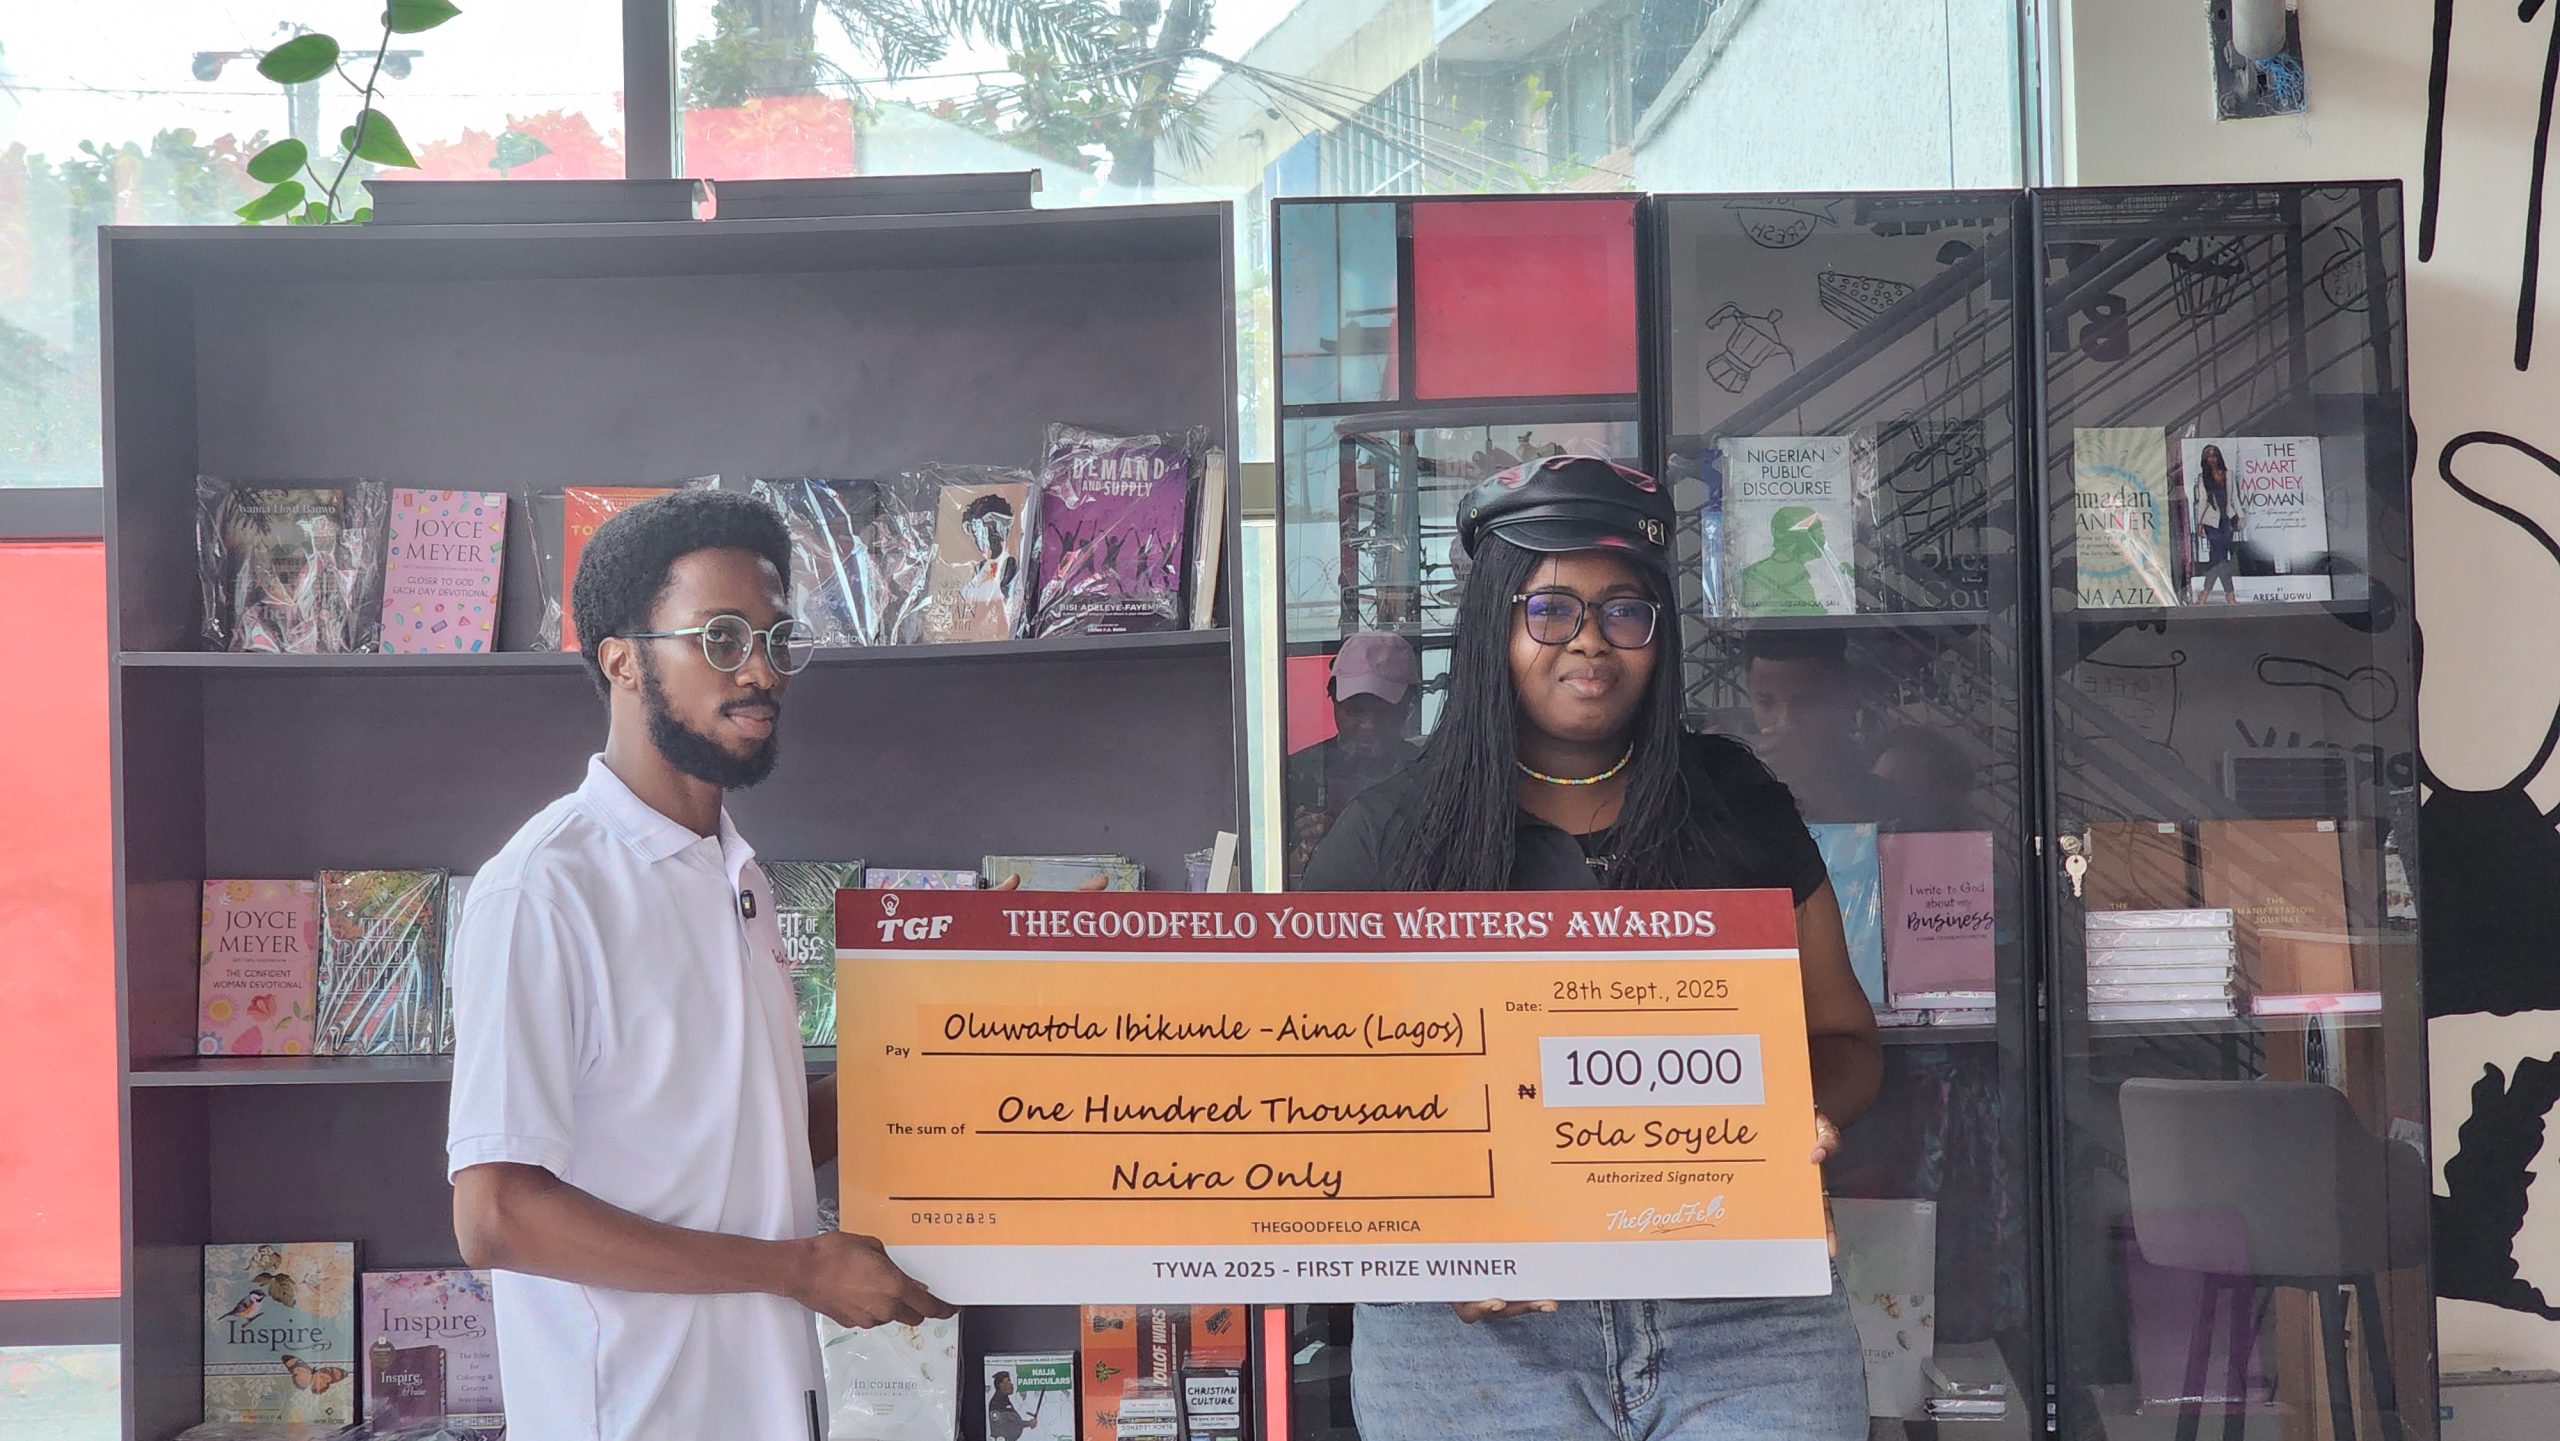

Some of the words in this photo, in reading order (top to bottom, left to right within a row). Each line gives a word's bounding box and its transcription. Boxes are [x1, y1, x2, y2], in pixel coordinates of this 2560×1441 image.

[1747, 449, 1826, 464] NIGERIAN
[2264, 443, 2295, 457] THE
[1073, 456, 1165, 481] DEMAND
[1761, 466, 1813, 480] PUBLIC
[2246, 460, 2297, 474] SMART
[1083, 480, 1101, 491] AND
[1103, 480, 1153, 497] SUPPLY
[1743, 481, 1832, 496] DISCOURSE
[2241, 476, 2303, 490] MONEY
[2239, 492, 2305, 506] WOMAN
[274, 504, 299, 515] Lloyd
[303, 504, 336, 514] Banwo
[2076, 511, 2156, 531] ANNER
[414, 519, 483, 540] JOYCE
[571, 525, 593, 536] TO
[406, 543, 484, 562] MEYER
[407, 576, 438, 585] CLOSER
[442, 577, 453, 586] TO
[455, 578, 474, 587] GOD
[393, 586, 415, 595] EACH
[418, 587, 436, 596] DAY
[438, 588, 490, 597] DEVOTIONAL
[2110, 588, 2155, 605] AZIZ
[2253, 593, 2280, 601] ARESE
[2283, 592, 2312, 600] UGWU
[1060, 603, 1078, 612] BISI
[1916, 884, 1942, 895] write
[1947, 885, 1958, 894] to
[1960, 881, 1984, 893] God
[1926, 897, 1955, 908] about
[225, 911, 297, 932] JOYCE
[805, 917, 819, 934] OF
[1002, 909, 1257, 940] THEGOODFELO
[1266, 907, 1384, 940] YOUNG
[1394, 906, 1553, 940] WRITERS'
[1567, 906, 1716, 939] AWARDS
[1907, 911, 1994, 932] Business
[2256, 915, 2300, 924] JOURNAL
[360, 917, 394, 938] THE
[876, 915, 953, 943] TGF
[219, 935, 299, 953] MEYER
[335, 939, 416, 965] POWER
[225, 969, 241, 977] THE
[244, 969, 291, 978] CONFIDENT
[213, 981, 246, 989] WOMAN
[249, 981, 302, 989] DEVOTIONAL
[1552, 981, 1602, 1001] 28th
[1609, 981, 1670, 1004] Sept.,
[1676, 979, 1729, 999] 2025
[1506, 1001, 1542, 1013] Date:
[943, 1012, 1108, 1041] Oluwatola
[1116, 1013, 1251, 1041] Ibikunle
[1363, 1012, 1464, 1048] (Lagos)
[886, 1045, 910, 1058] Pay
[1566, 1048, 1742, 1092] 100,000
[998, 1095, 1074, 1123] One
[1084, 1094, 1251, 1123] Hundred
[1260, 1093, 1448, 1123] Thousand
[887, 1123, 913, 1135] The
[916, 1125, 948, 1135] sum
[951, 1122, 965, 1135] of
[1555, 1119, 1635, 1149] Sola
[1644, 1118, 1758, 1154] Soyele
[1112, 1161, 1235, 1191] Naira
[1245, 1161, 1343, 1199] Only
[1586, 1170, 1663, 1183] Authorized
[1667, 1170, 1734, 1184] Signatory
[1252, 1221, 1364, 1233] THEGOODFELO
[1368, 1220, 1421, 1233] AFRICA
[1153, 1261, 1217, 1278] TYWA
[1224, 1261, 1275, 1278] 2025
[1297, 1260, 1354, 1278] FIRST
[1361, 1260, 1420, 1277] PRIZE
[1425, 1259, 1518, 1276] WINNER
[381, 1306, 486, 1339] Inspire
[1152, 1308, 1167, 1344] WARS
[227, 1318, 332, 1352] Inspire
[459, 1352, 472, 1360] The
[381, 1369, 423, 1386] Inspire
[1032, 1368, 1056, 1376] NAIJA
[1017, 1377, 1071, 1386] PARTICULARS
[1187, 1386, 1237, 1396] CHRISTIAN
[1190, 1397, 1234, 1406] CULTURE
